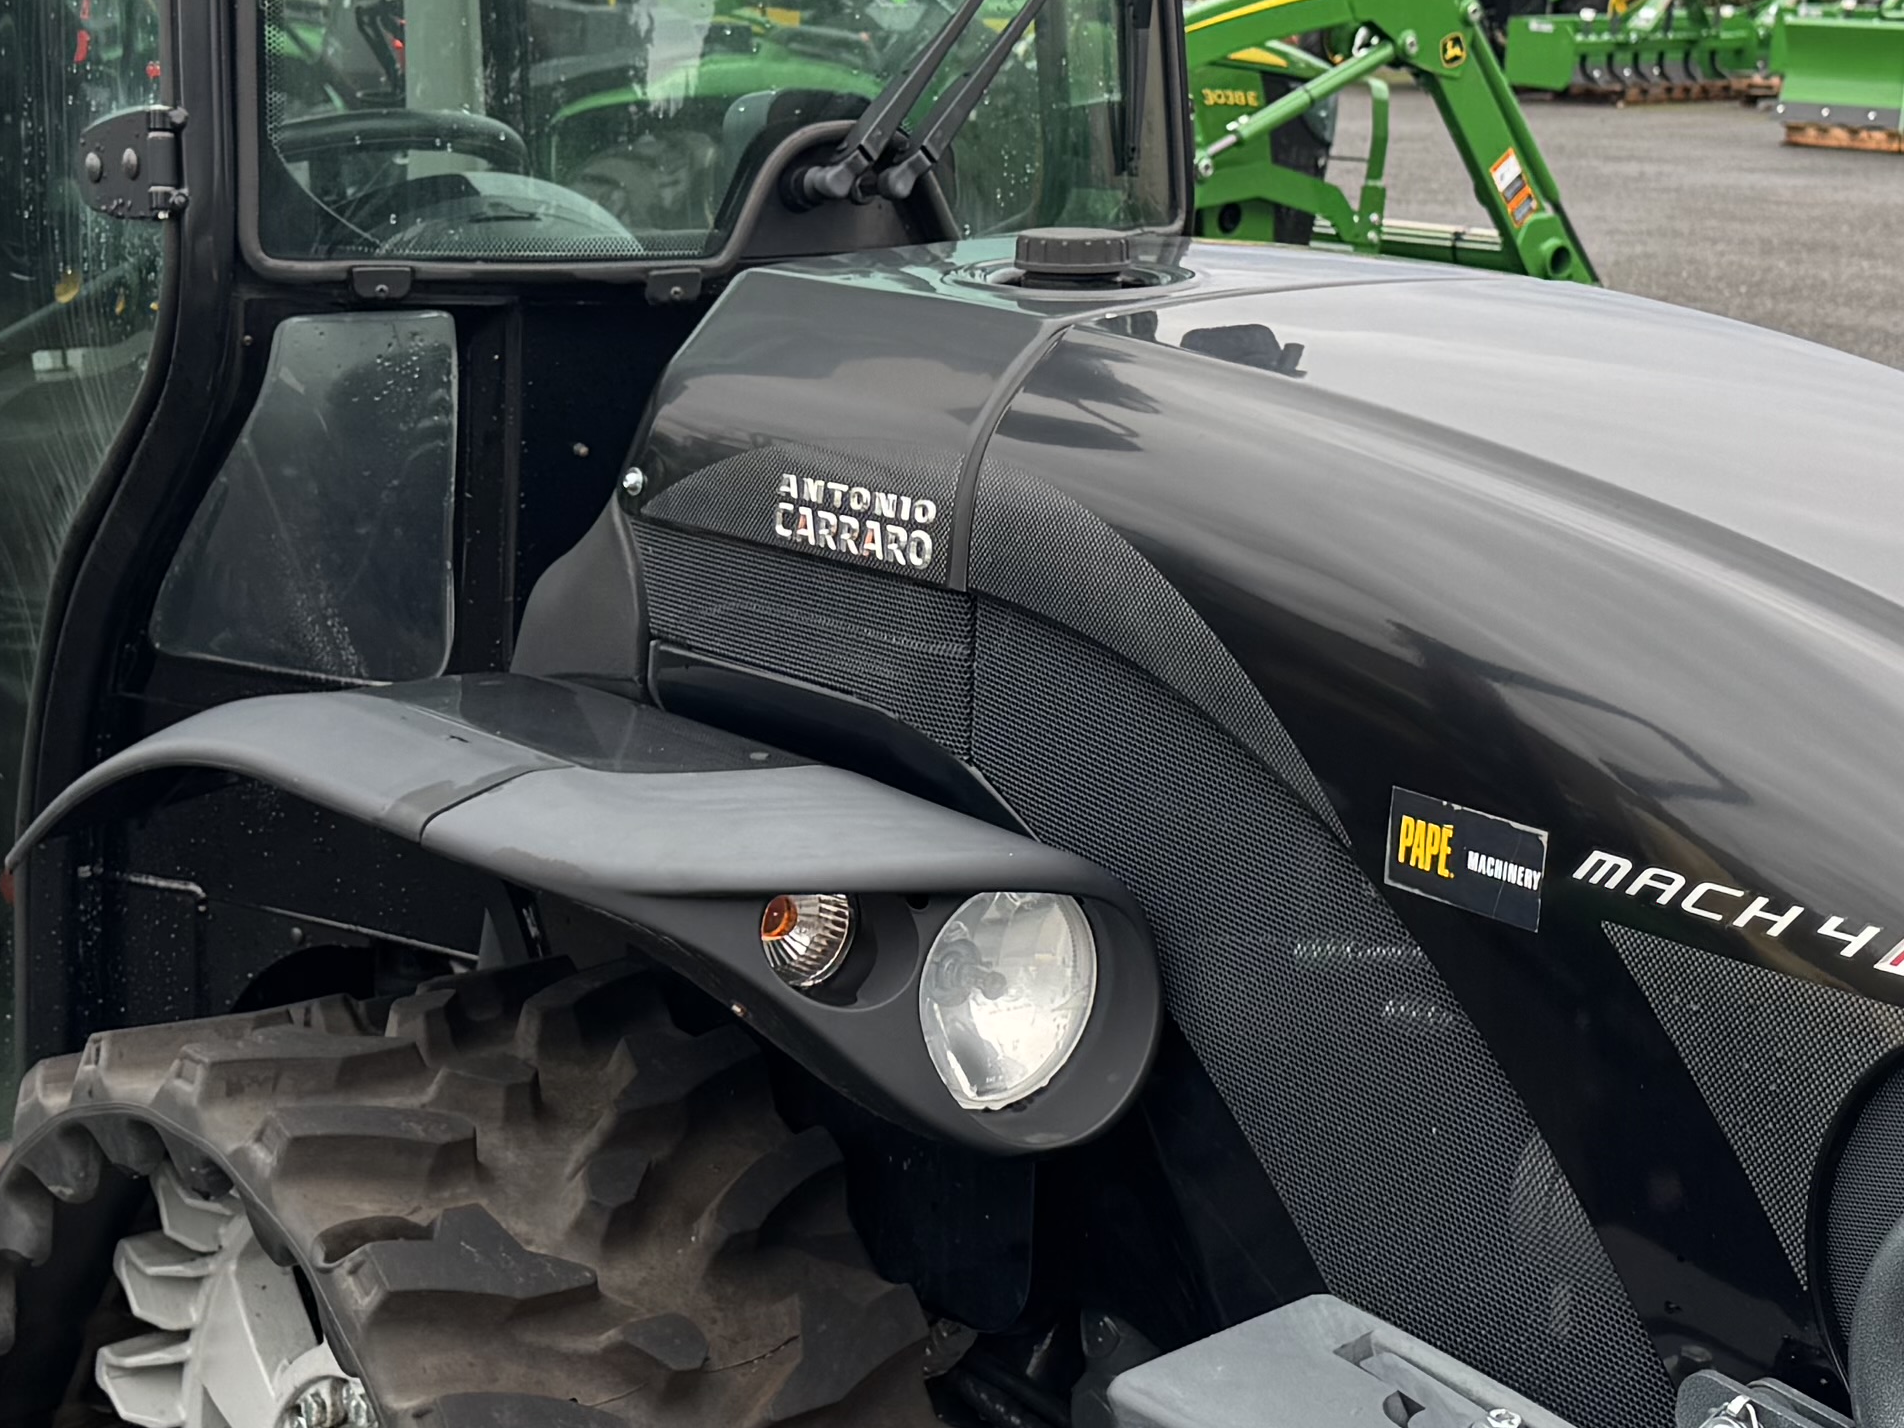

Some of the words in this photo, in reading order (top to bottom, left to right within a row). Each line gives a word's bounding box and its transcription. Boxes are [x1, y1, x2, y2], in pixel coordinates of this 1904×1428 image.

[778, 472, 938, 524] ANTONIO
[774, 501, 934, 570] CARRARO
[1466, 850, 1543, 892] MACHINERY
[1572, 849, 1805, 938] MACH
